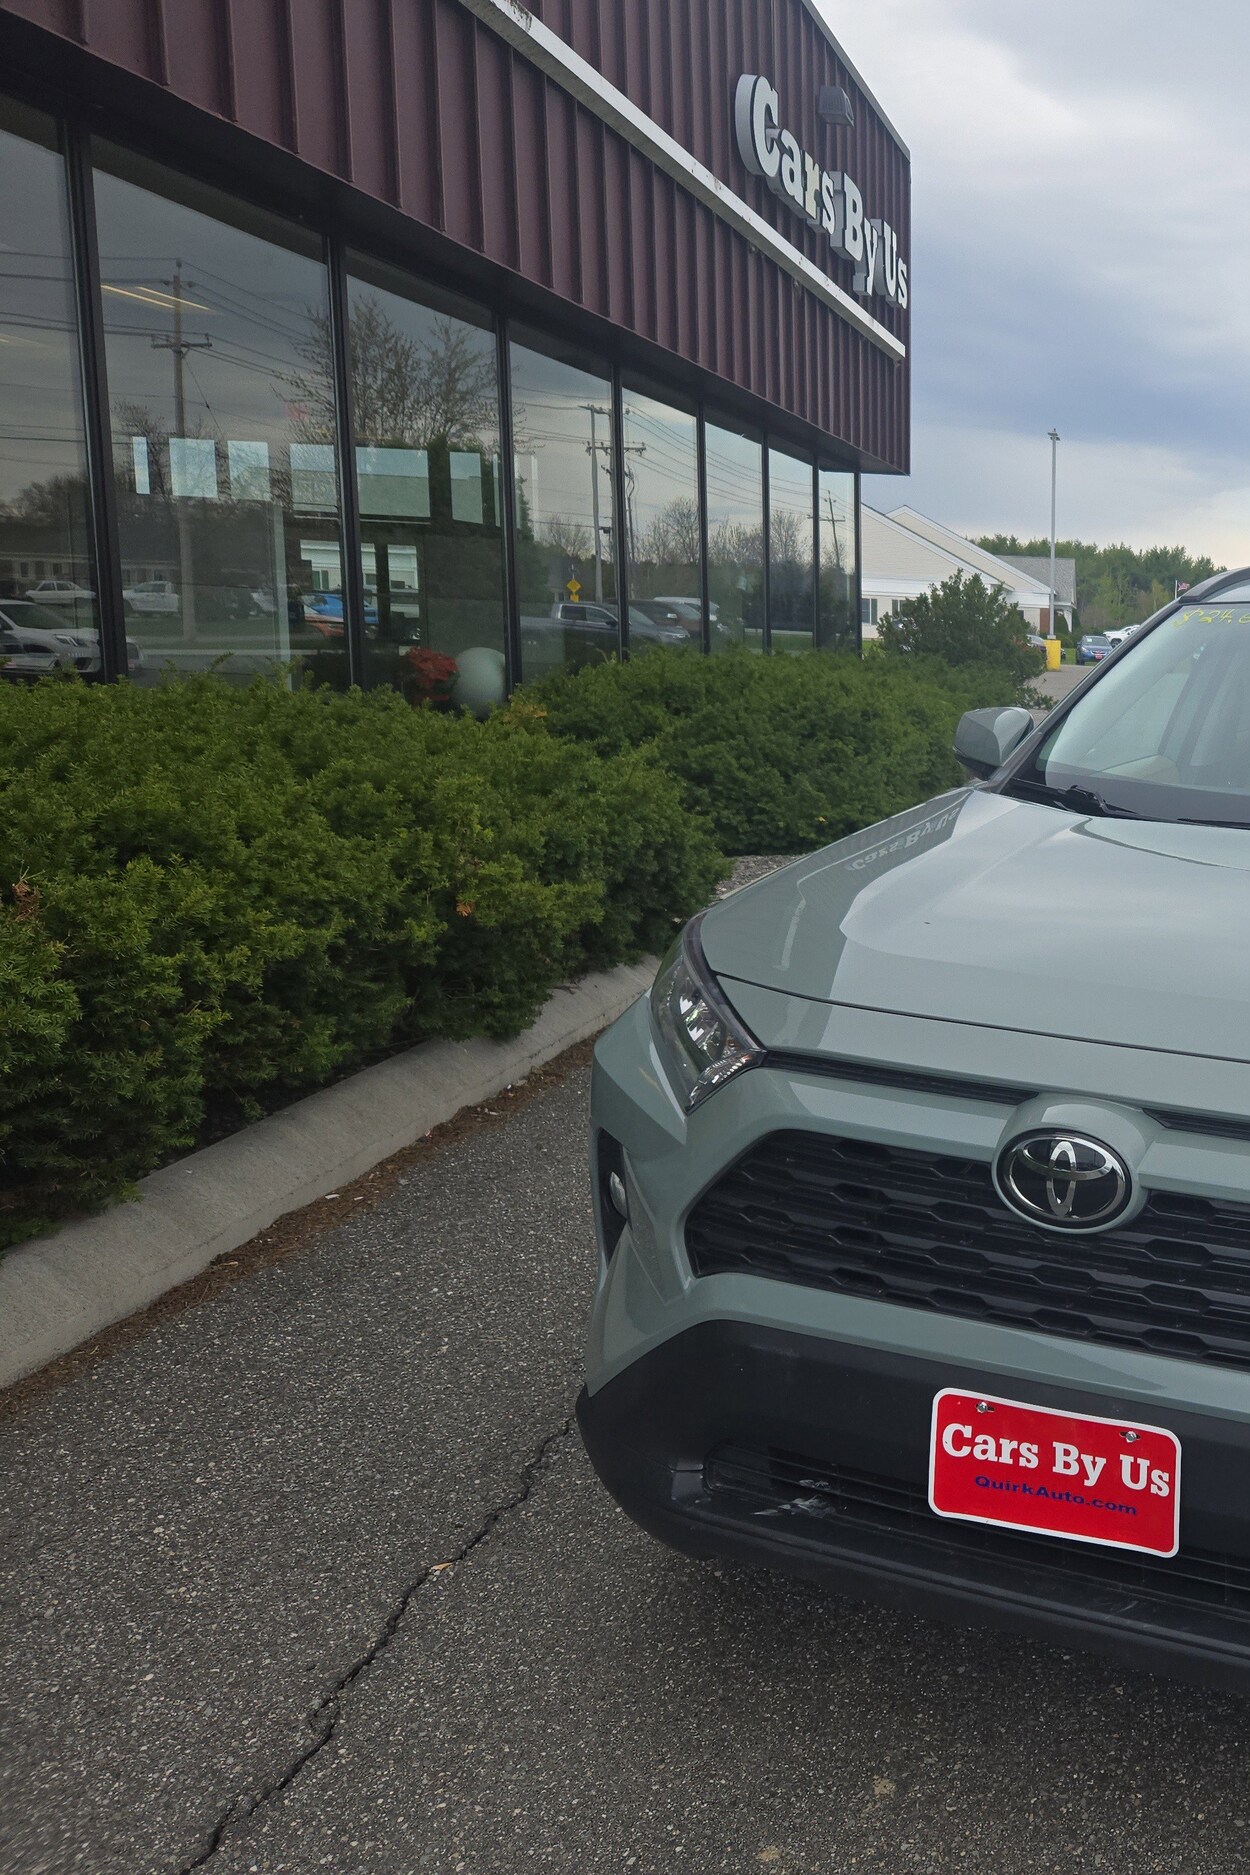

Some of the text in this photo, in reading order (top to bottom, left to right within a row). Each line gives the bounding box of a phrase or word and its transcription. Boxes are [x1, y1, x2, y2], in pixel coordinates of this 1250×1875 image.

[748, 74, 907, 310] Cars By Us
[942, 1422, 1170, 1497] Cars By Us
[973, 1474, 1138, 1516] QuirkAuto.com
